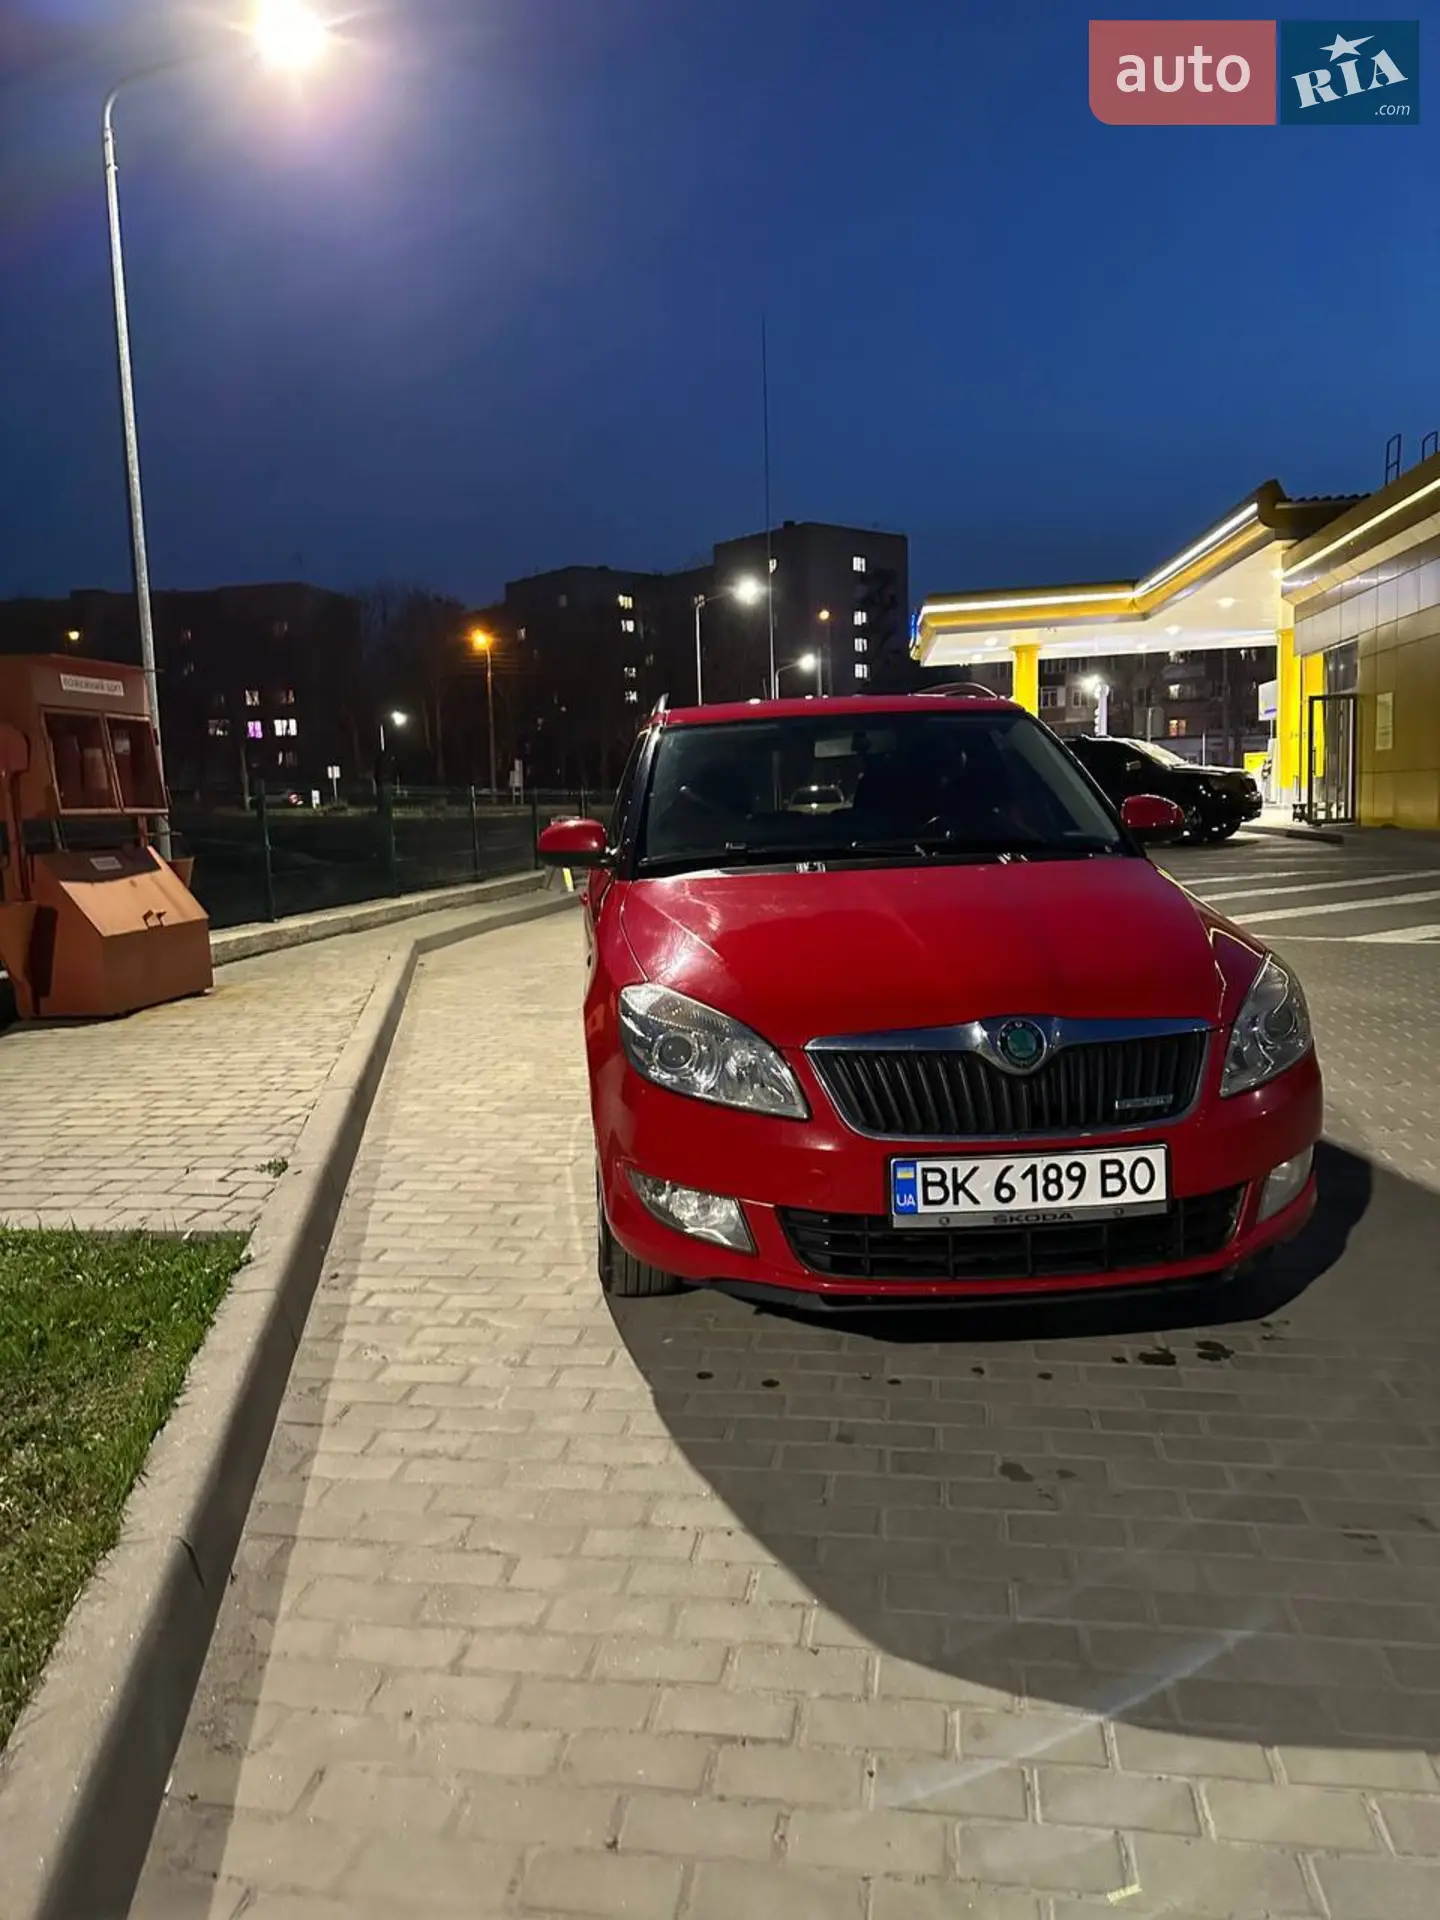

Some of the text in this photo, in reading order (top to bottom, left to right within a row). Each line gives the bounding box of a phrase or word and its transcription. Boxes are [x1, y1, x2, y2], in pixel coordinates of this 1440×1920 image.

[921, 1156, 1156, 1206] BK 6189 BO
[896, 1193, 916, 1207] UA
